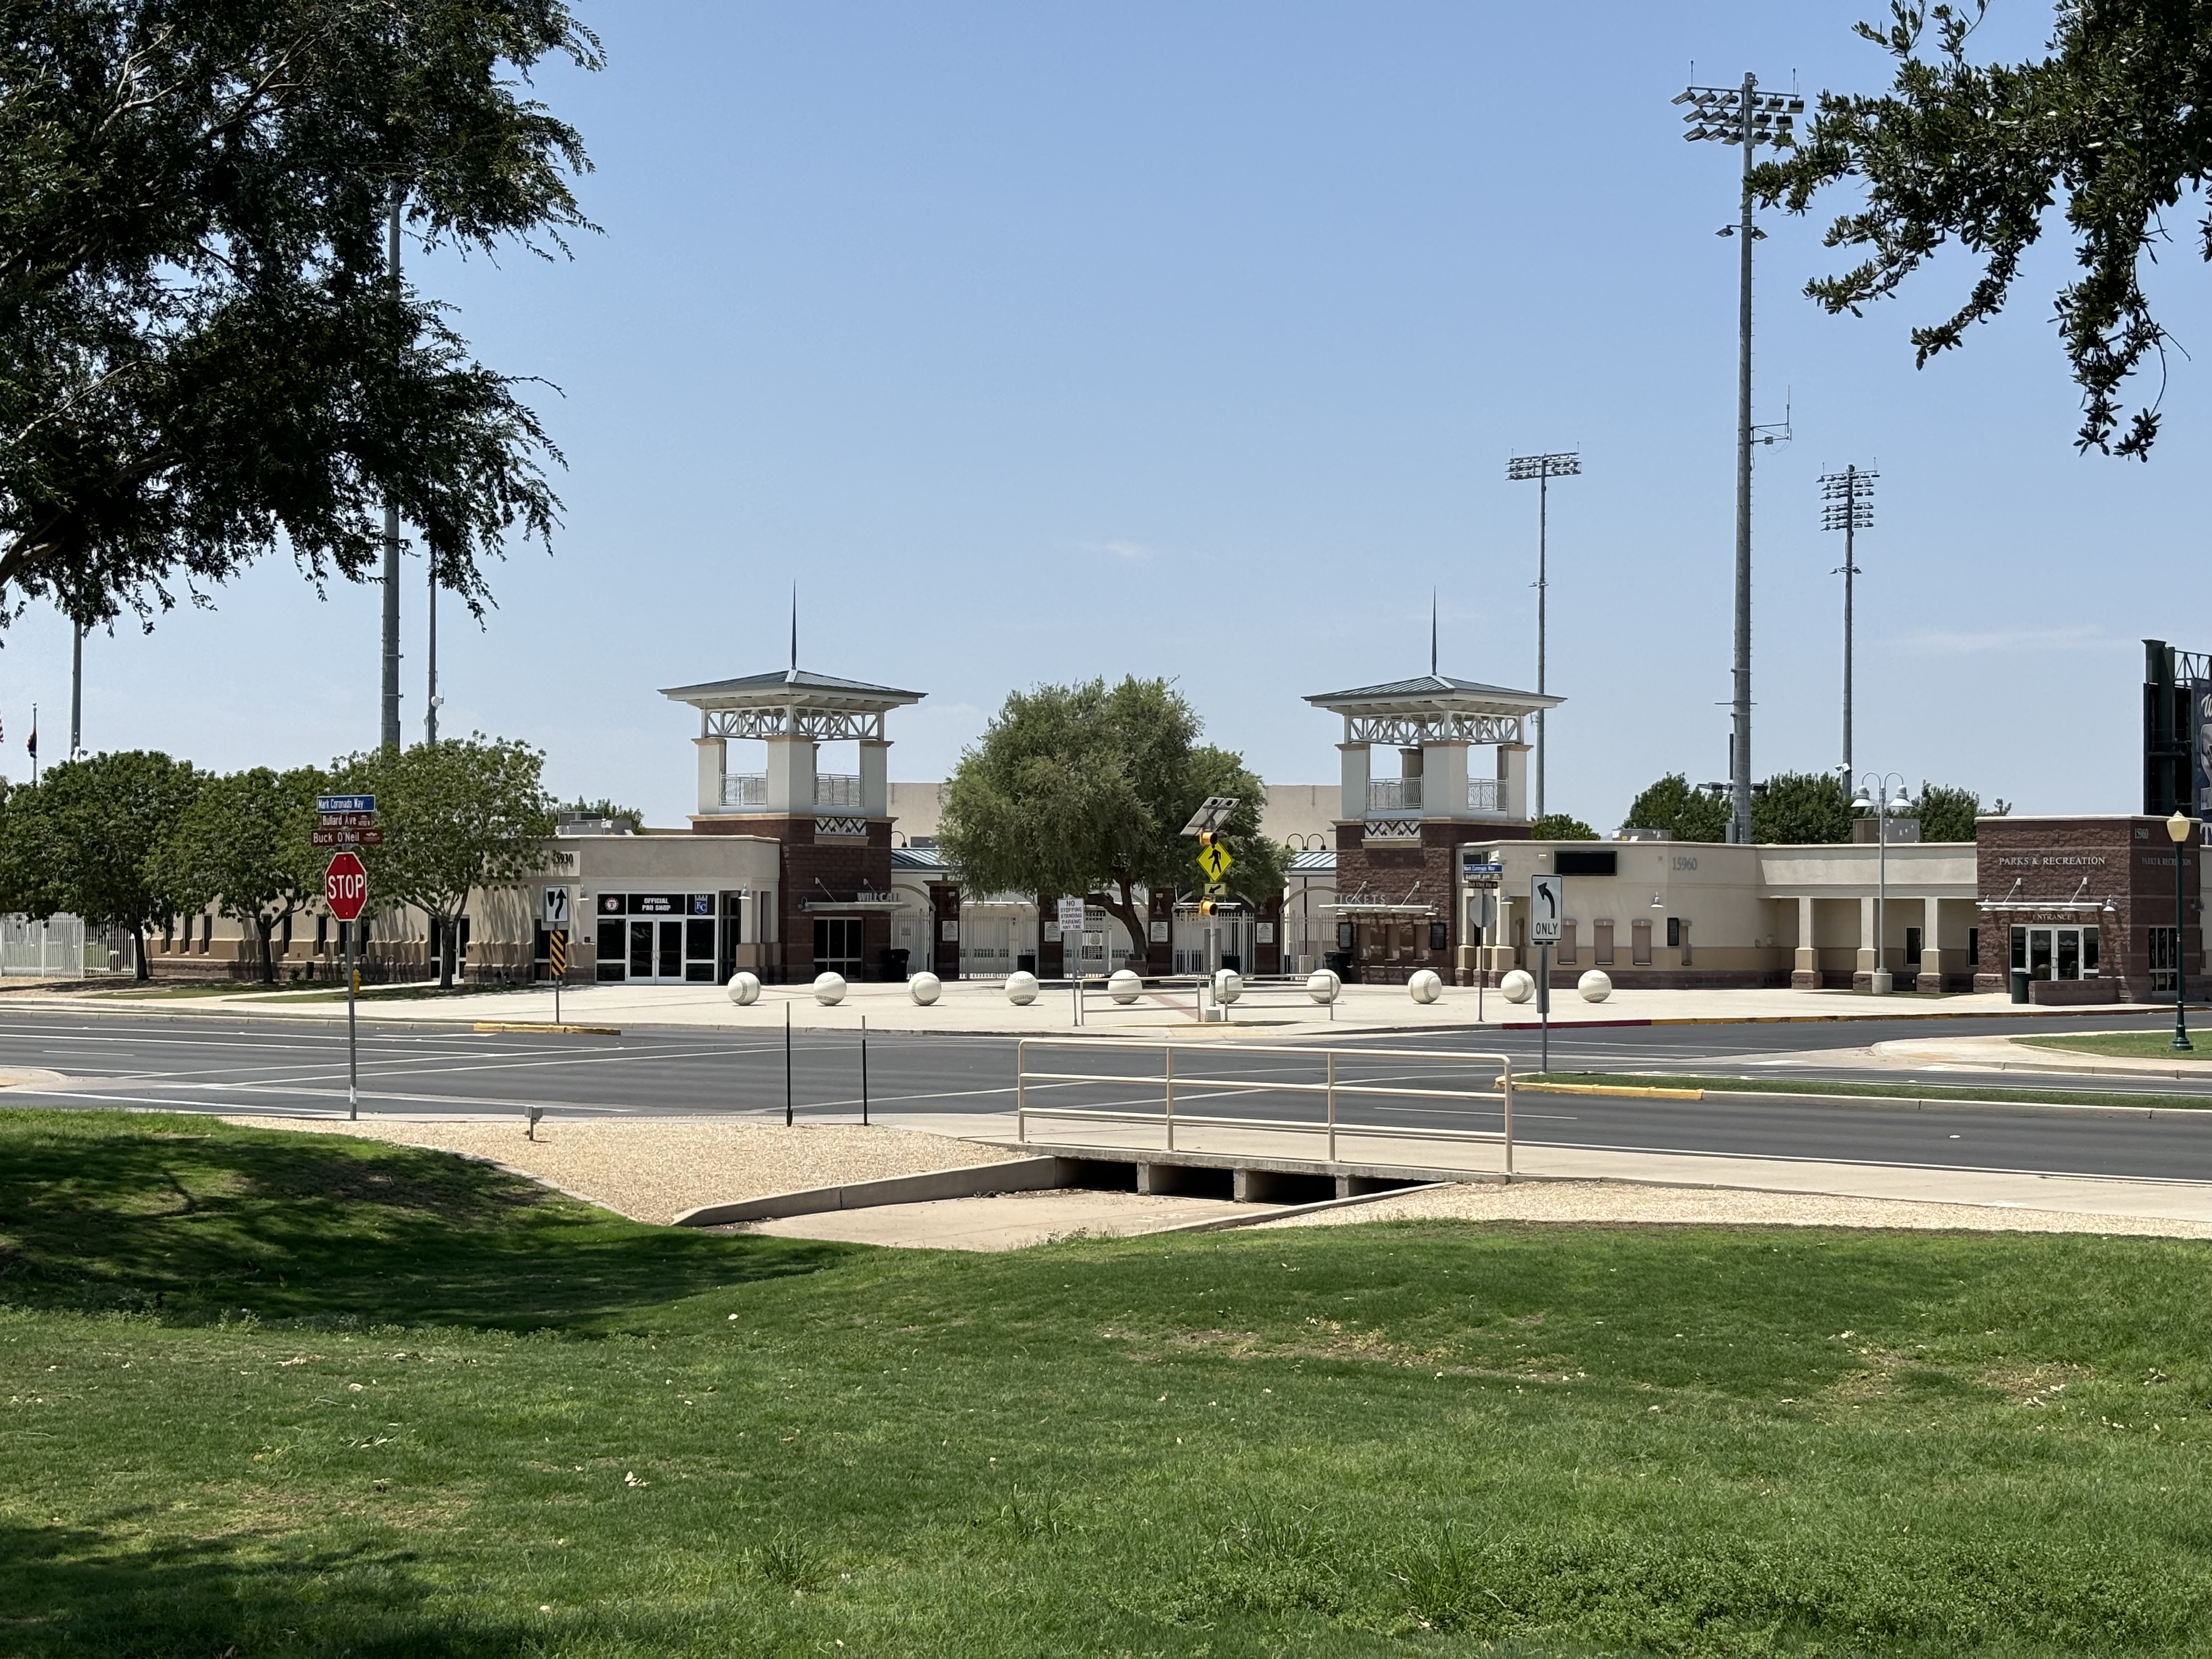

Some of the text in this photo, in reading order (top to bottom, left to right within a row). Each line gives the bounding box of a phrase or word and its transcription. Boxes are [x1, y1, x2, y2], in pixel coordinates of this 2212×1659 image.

[318, 798, 364, 809] Mark Coronado Way
[323, 815, 342, 826] Bullard
[345, 815, 357, 825] Ave
[313, 832, 333, 843] Buck
[337, 832, 359, 842] O'Neil
[1672, 856, 1697, 871] 15960
[1999, 856, 2107, 865] PARKS & RECREATION
[328, 873, 364, 900] STOP
[856, 892, 878, 902] WILL
[1536, 922, 1559, 935] ONLY
